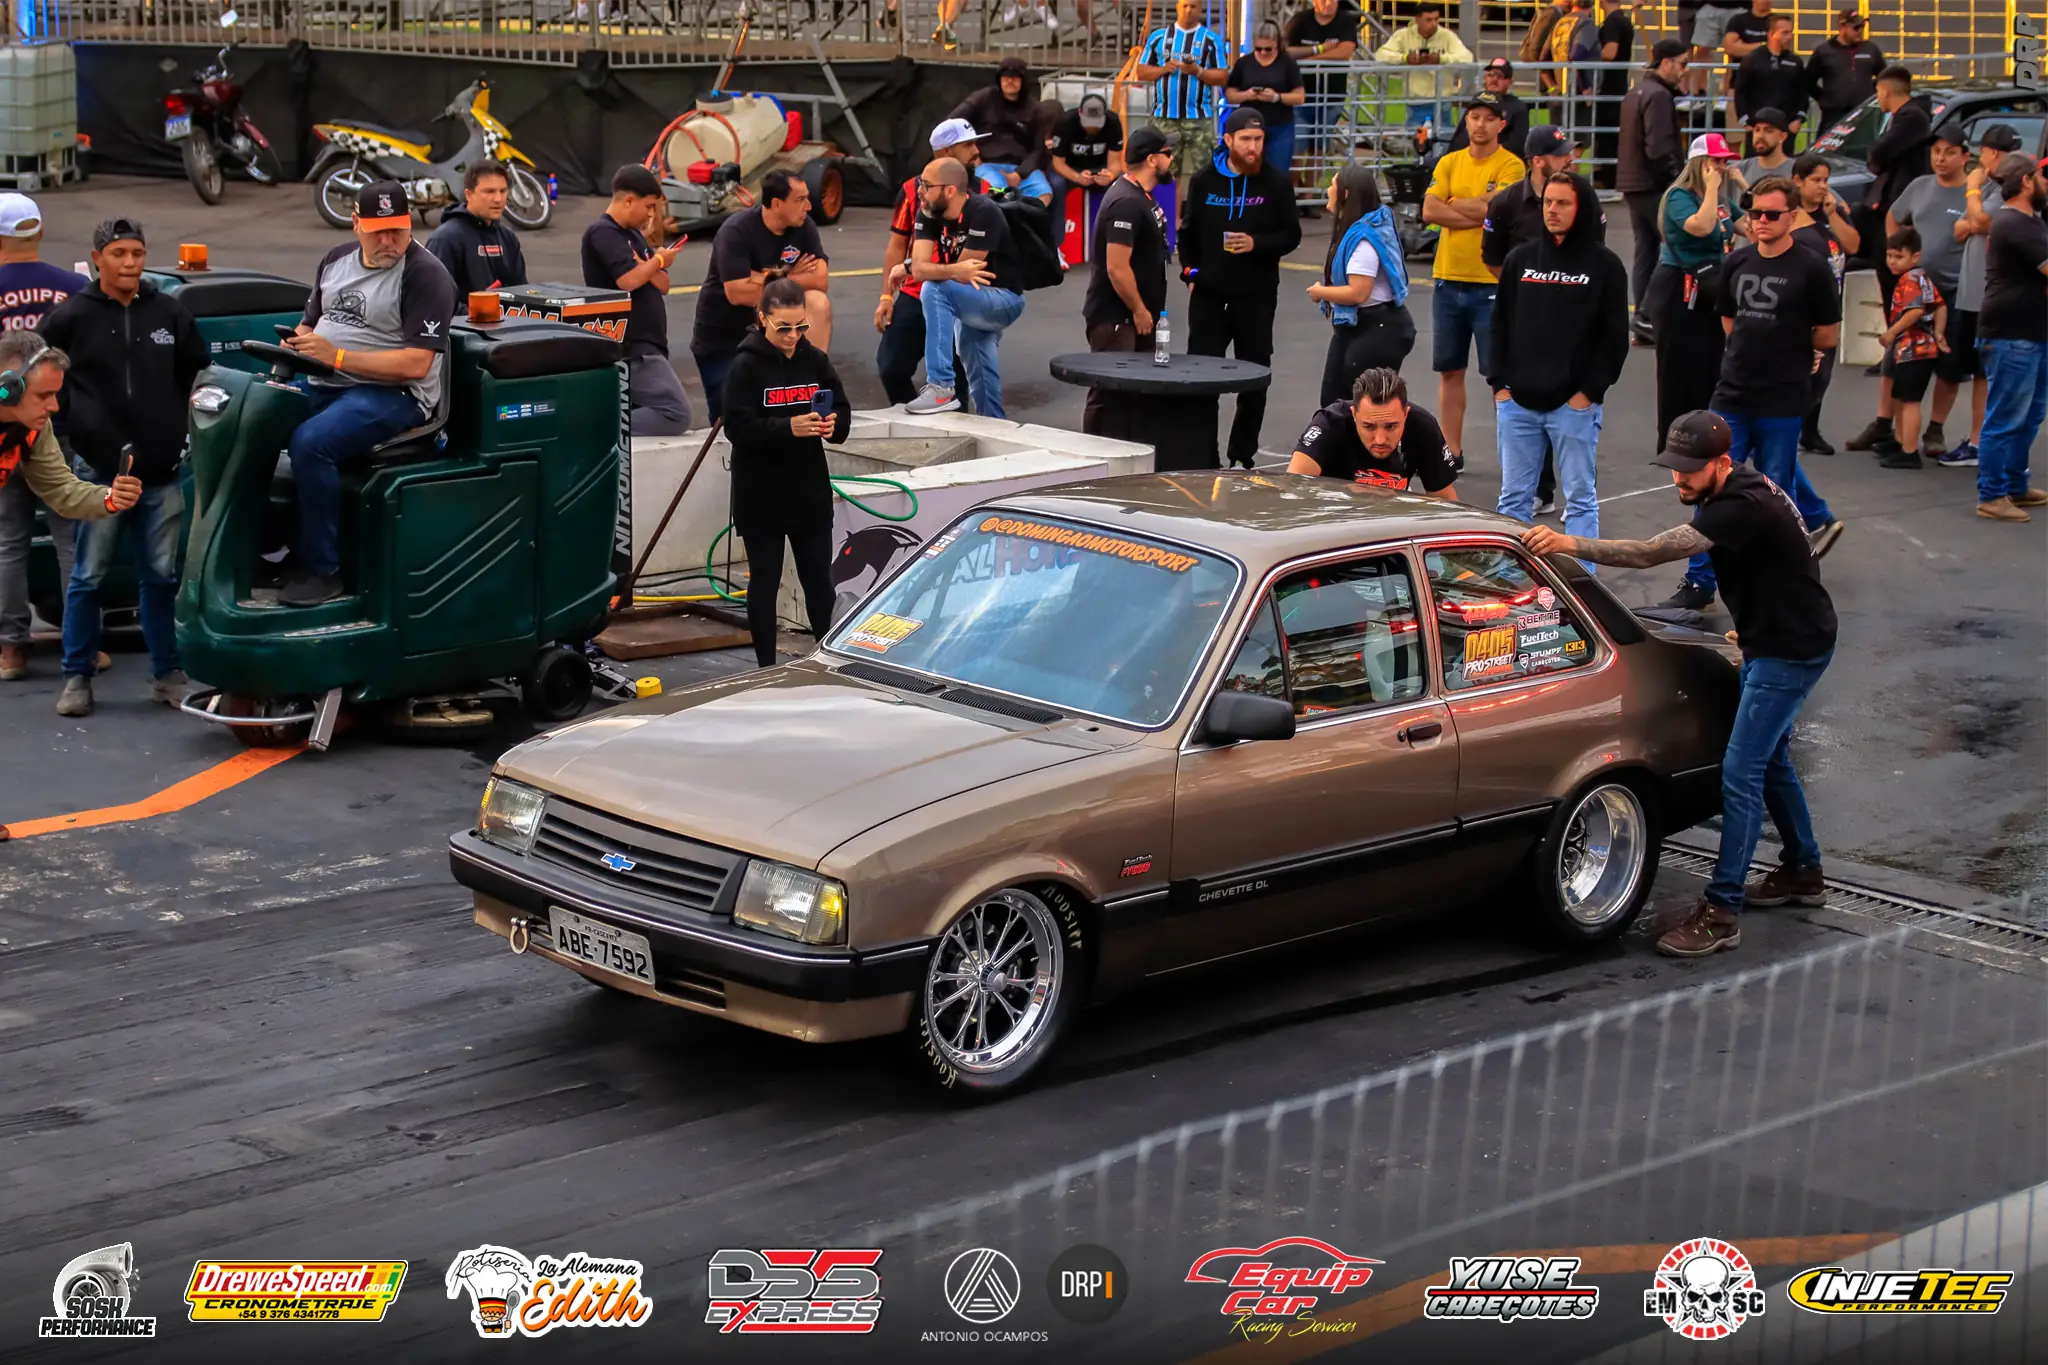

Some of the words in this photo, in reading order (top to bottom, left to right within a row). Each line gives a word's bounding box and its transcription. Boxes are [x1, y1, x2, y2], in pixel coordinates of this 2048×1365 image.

[1521, 268, 1590, 285] FuelTech
[1465, 629, 1515, 663] 0405
[1520, 630, 1559, 647] FuelTech
[1198, 883, 1253, 902] CHEVETTE
